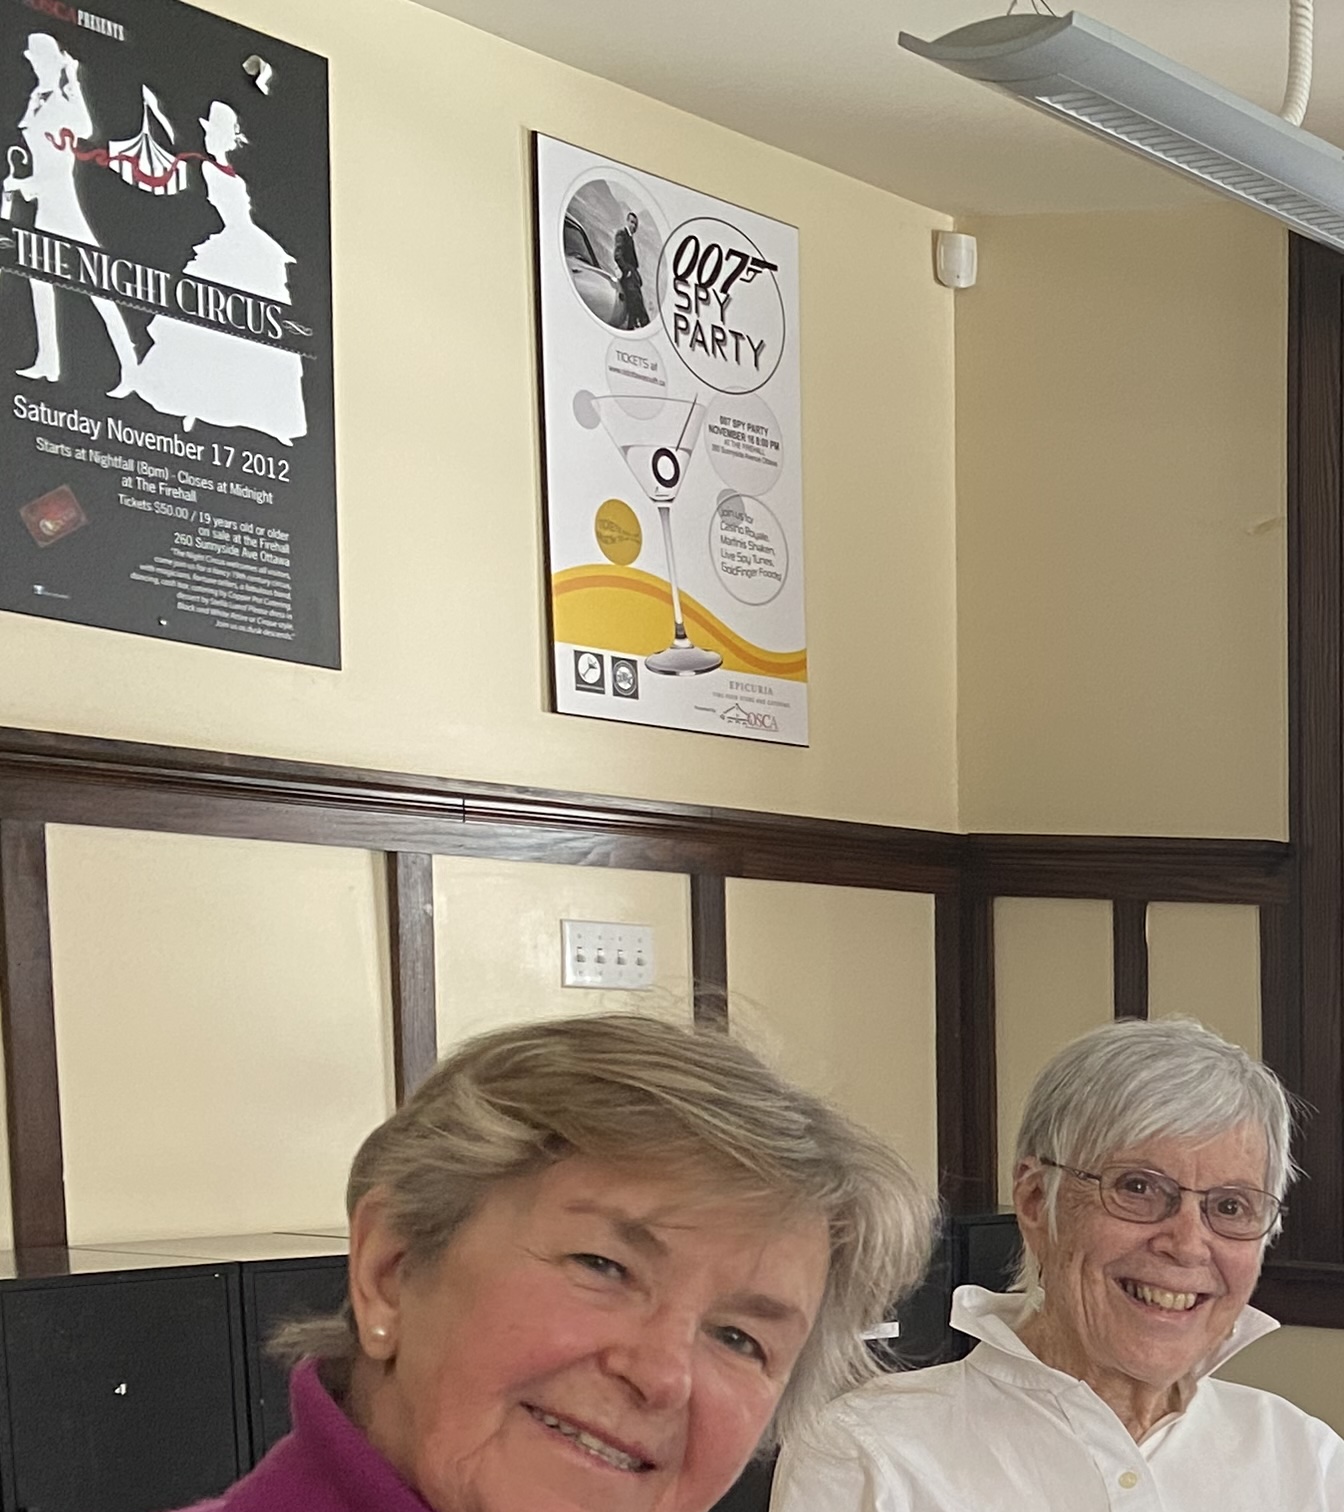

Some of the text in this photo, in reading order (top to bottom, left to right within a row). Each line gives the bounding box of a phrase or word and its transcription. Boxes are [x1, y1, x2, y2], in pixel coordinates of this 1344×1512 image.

[77, 9, 125, 41] PRESENTS
[673, 235, 752, 294] 007
[12, 227, 283, 340] THE NIGHT CIRCUS
[673, 277, 732, 325] SPY
[673, 312, 766, 372] PARTY
[615, 350, 650, 369] TICKETS
[13, 394, 290, 483] Saturday November 17 2012
[708, 424, 746, 442] NOVEMBER
[746, 423, 769, 437] PARTY
[36, 437, 73, 458] Starts
[74, 448, 88, 461] at
[89, 449, 135, 472] Nightfall
[136, 460, 170, 481] (8pm)
[177, 470, 215, 491] Closes
[216, 482, 228, 494] at
[229, 482, 273, 505] Midnight
[121, 476, 198, 503] at The Firehall
[117, 493, 152, 512] Tickets
[153, 500, 189, 520] $50.00
[199, 511, 212, 525] 19
[212, 517, 238, 530] years
[239, 523, 254, 534] old
[255, 527, 266, 536] or
[266, 528, 290, 542] older
[720, 520, 745, 535] Casino
[173, 532, 291, 568] 260 Sunnyside Ave Ottawa
[212, 530, 231, 542] sale
[232, 534, 242, 545] at
[243, 535, 258, 548] the
[259, 538, 291, 555] Firehall
[736, 551, 752, 566] Spy
[729, 681, 774, 696] EPICURIA
[747, 712, 779, 731] OSCA
